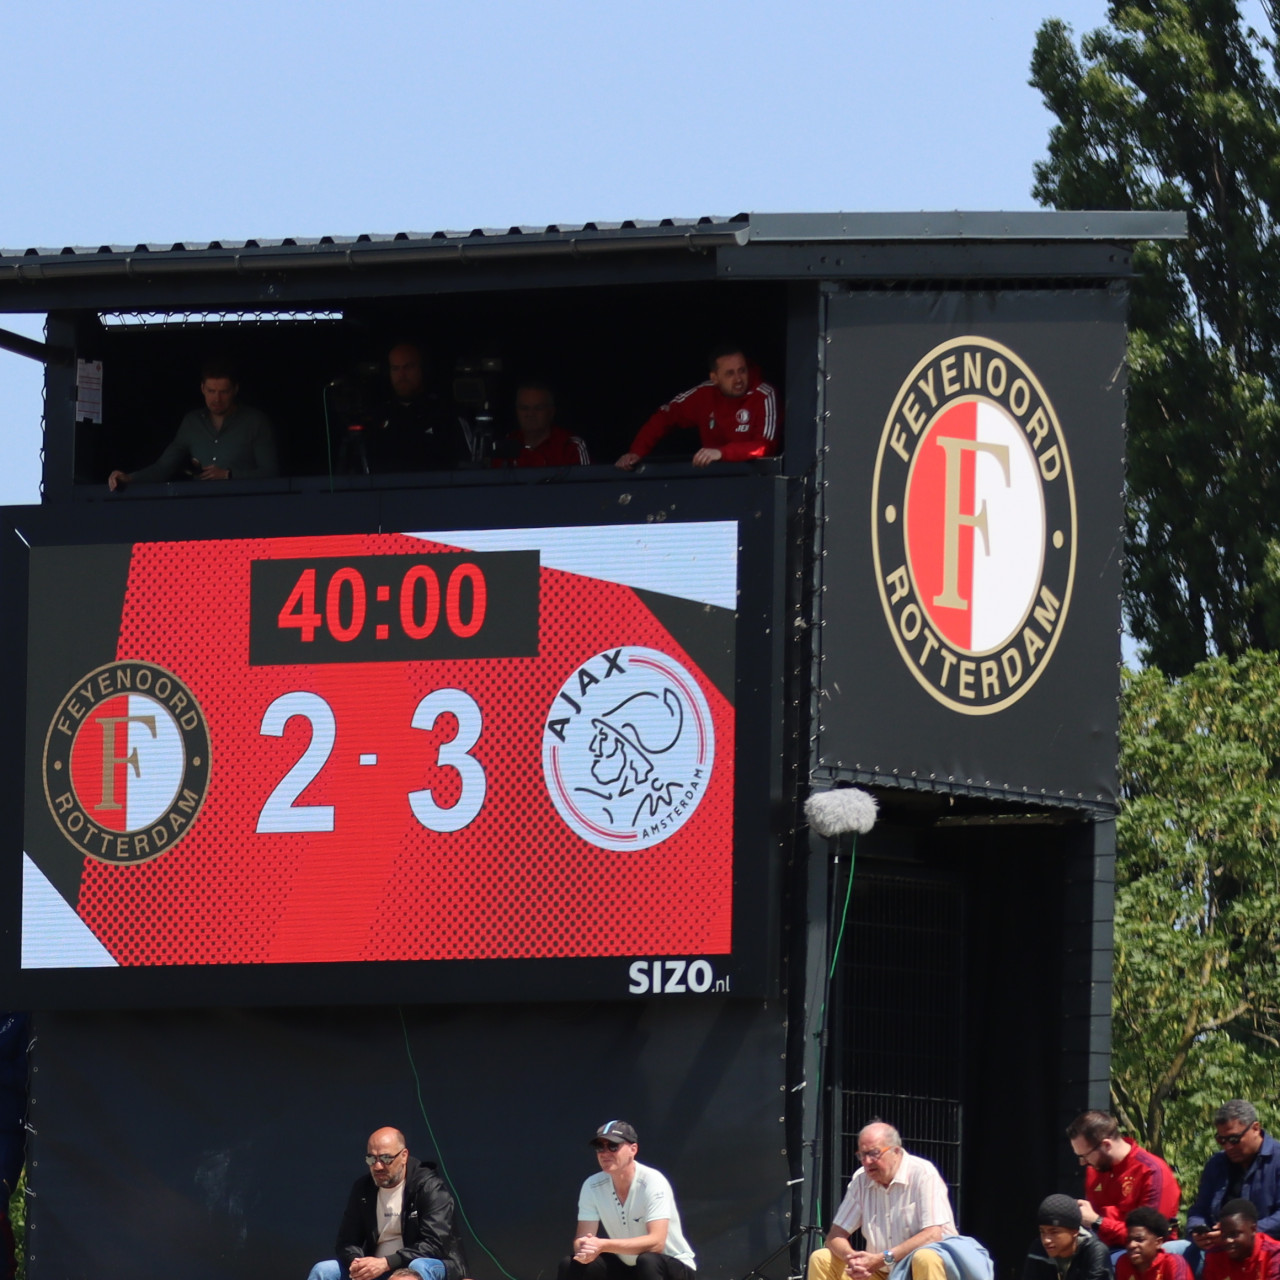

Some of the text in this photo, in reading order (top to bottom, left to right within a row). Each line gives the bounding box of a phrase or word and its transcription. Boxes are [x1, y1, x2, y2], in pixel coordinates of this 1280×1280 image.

[889, 351, 1062, 482] FEYENOORD
[933, 435, 1012, 611] F
[277, 562, 487, 643] 40:00
[885, 564, 1061, 700] ROTTERDAM
[57, 667, 199, 736] FEYENOORD
[547, 648, 627, 744] AJAX
[93, 714, 158, 811] F
[255, 690, 337, 834] 2
[407, 687, 488, 834] 3
[641, 767, 704, 840] AMSTERDAM
[54, 787, 200, 857] ROTTERDAM
